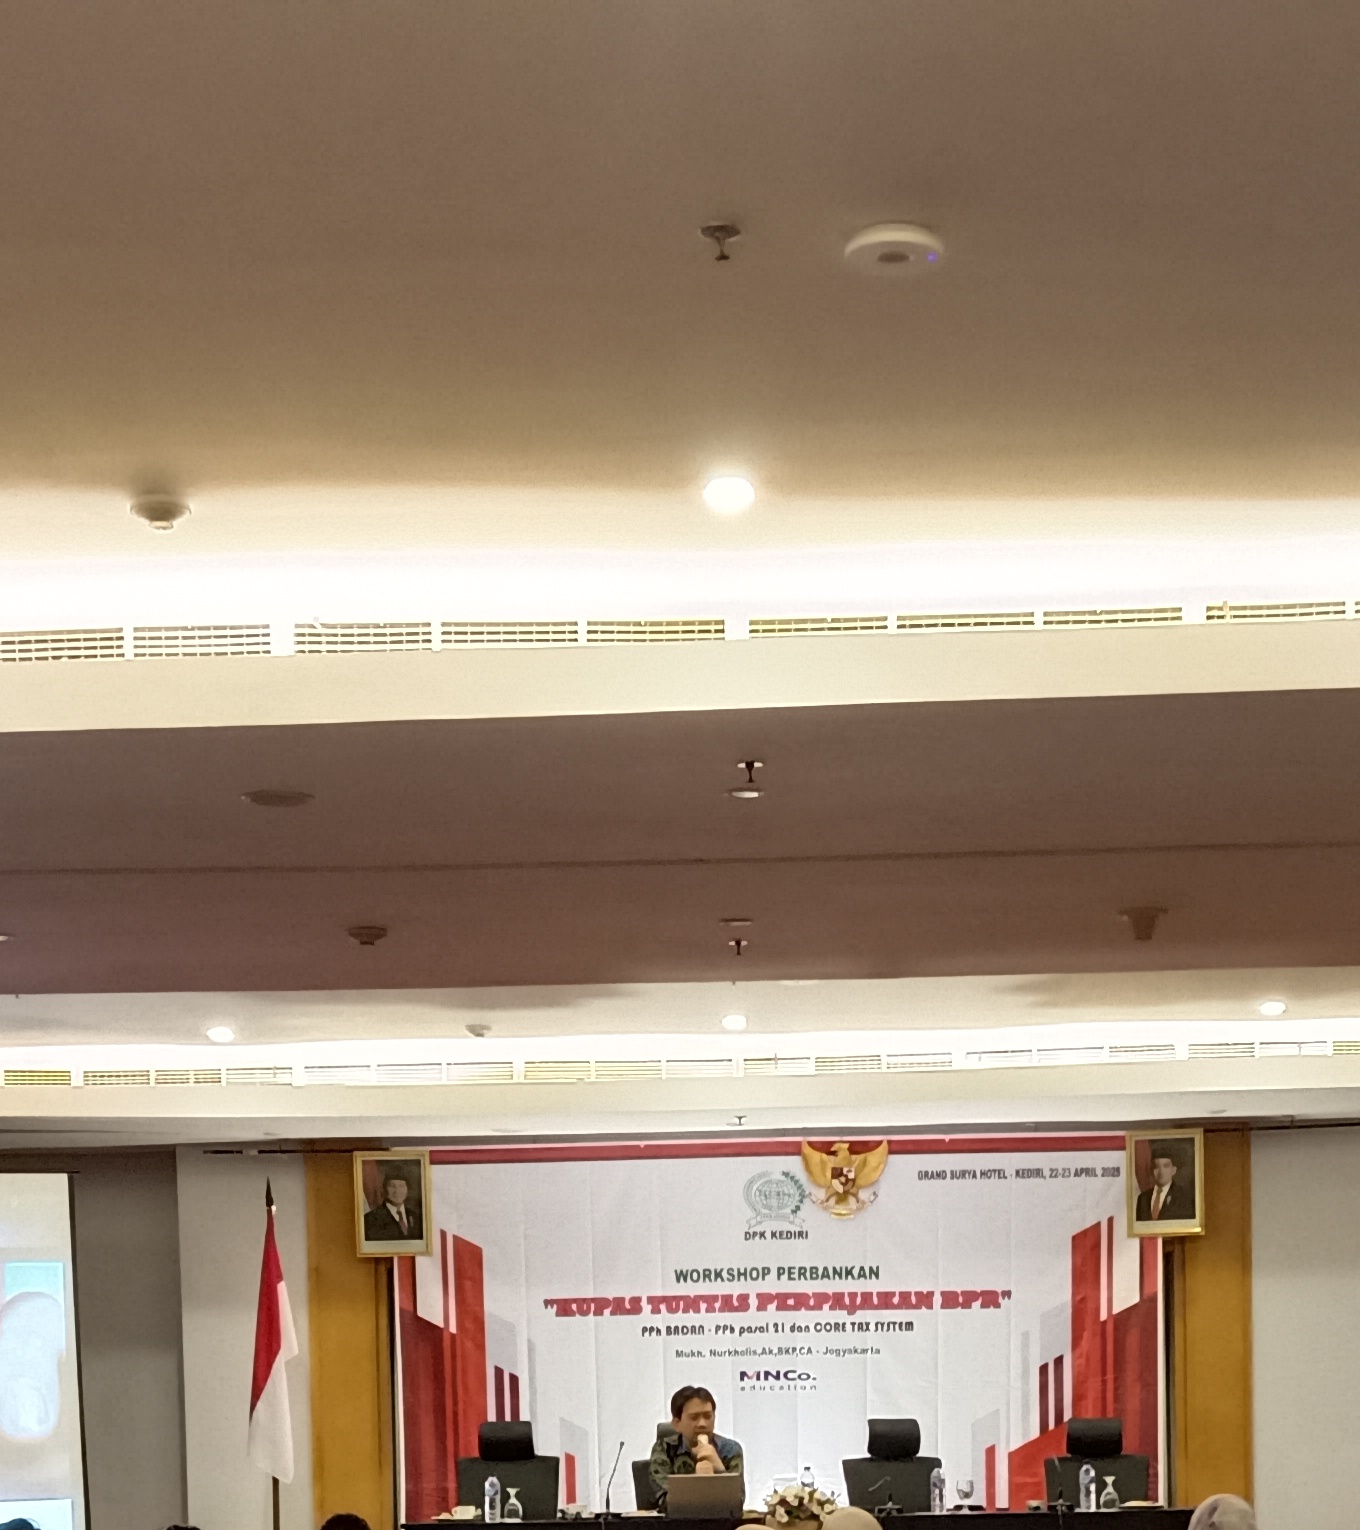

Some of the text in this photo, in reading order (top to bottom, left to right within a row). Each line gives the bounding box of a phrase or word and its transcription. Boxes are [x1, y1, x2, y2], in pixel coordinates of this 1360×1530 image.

[917, 1169, 947, 1181] GRAND
[949, 1169, 978, 1180] SURYA
[980, 1168, 1008, 1180] HOTEL
[1048, 1167, 1072, 1179] 22-23
[1073, 1167, 1099, 1178] APRIL
[744, 1230, 809, 1241] DPK KEDIRI
[674, 1265, 880, 1284] WORKSHOP PERBANKAN
[646, 1292, 751, 1315] TUNTAS
[755, 1290, 935, 1316] PERPAJAKAN
[665, 1325, 705, 1337] BADAN
[738, 1322, 769, 1337] pasal
[789, 1322, 811, 1334] dan
[813, 1322, 847, 1333] CORE
[850, 1321, 871, 1333] TAX
[873, 1321, 915, 1333] SYSTEM
[739, 1369, 817, 1382] MNCo.
